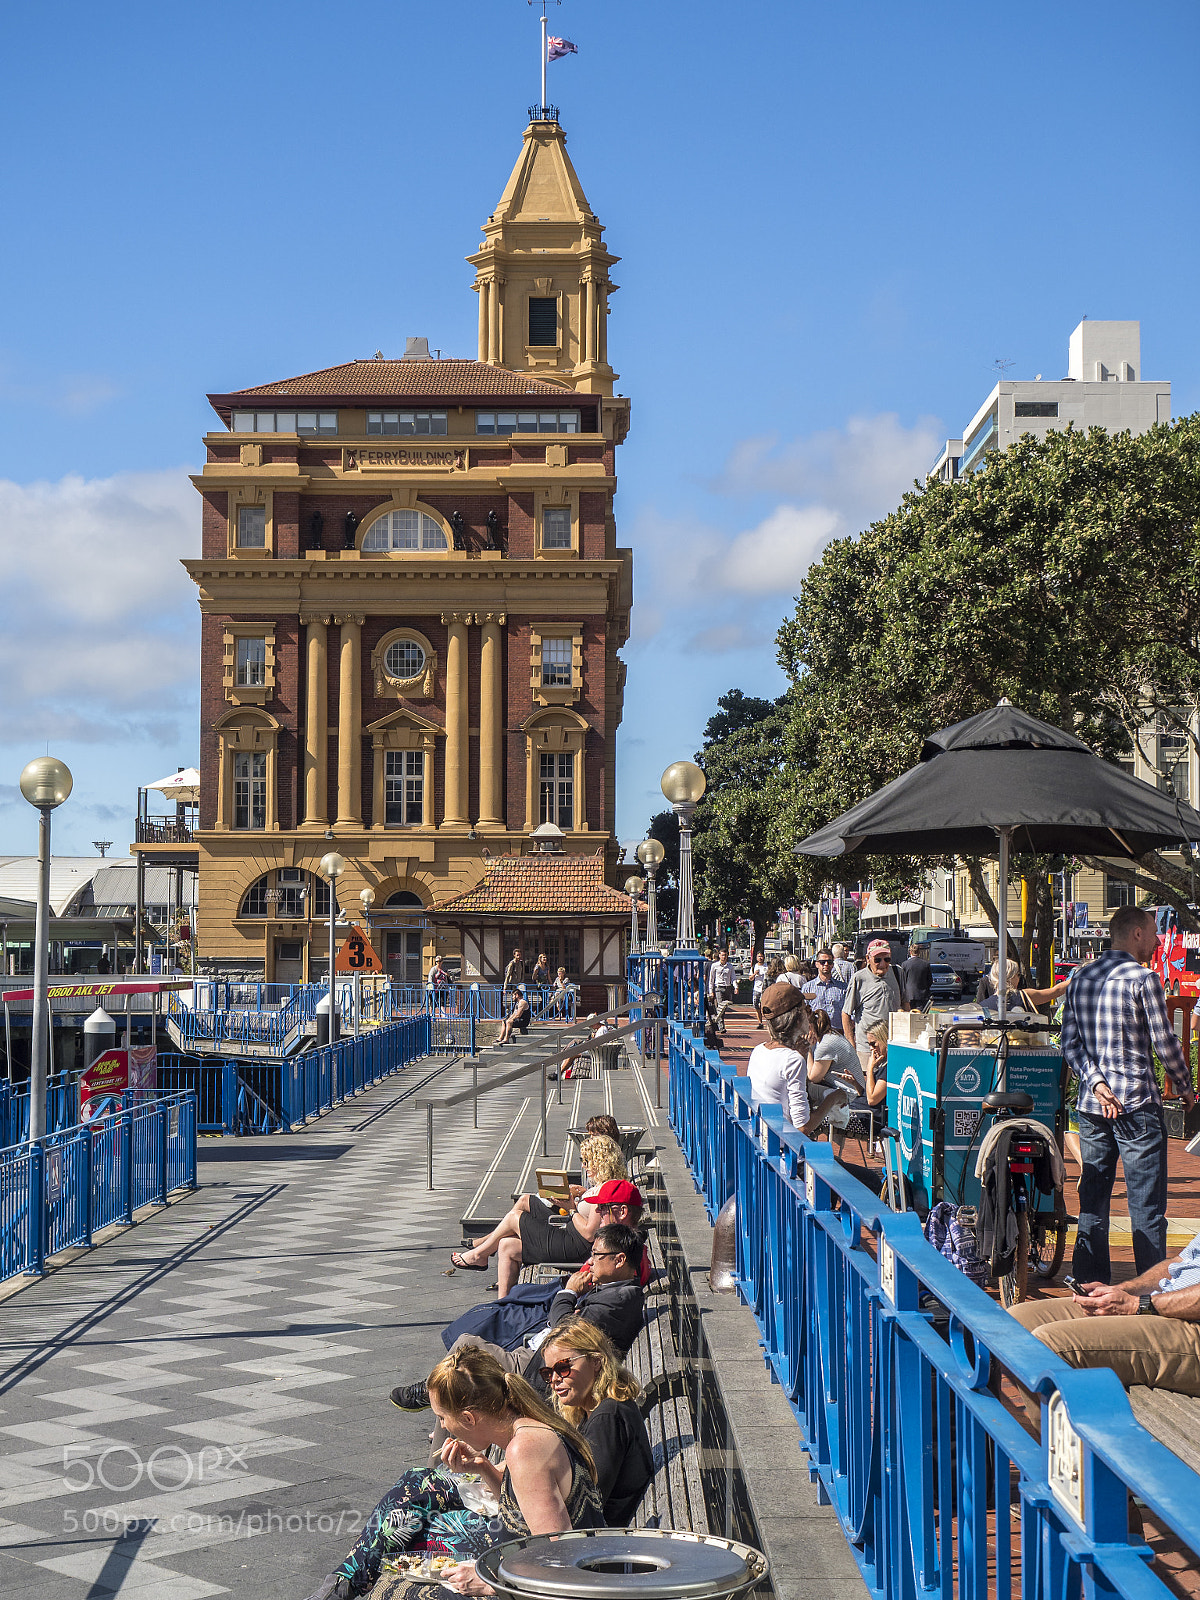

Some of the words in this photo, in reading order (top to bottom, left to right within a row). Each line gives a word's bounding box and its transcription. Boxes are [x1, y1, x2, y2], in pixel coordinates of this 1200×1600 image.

[47, 986, 74, 998] 0800
[74, 985, 93, 996] AKL
[95, 984, 115, 995] JET
